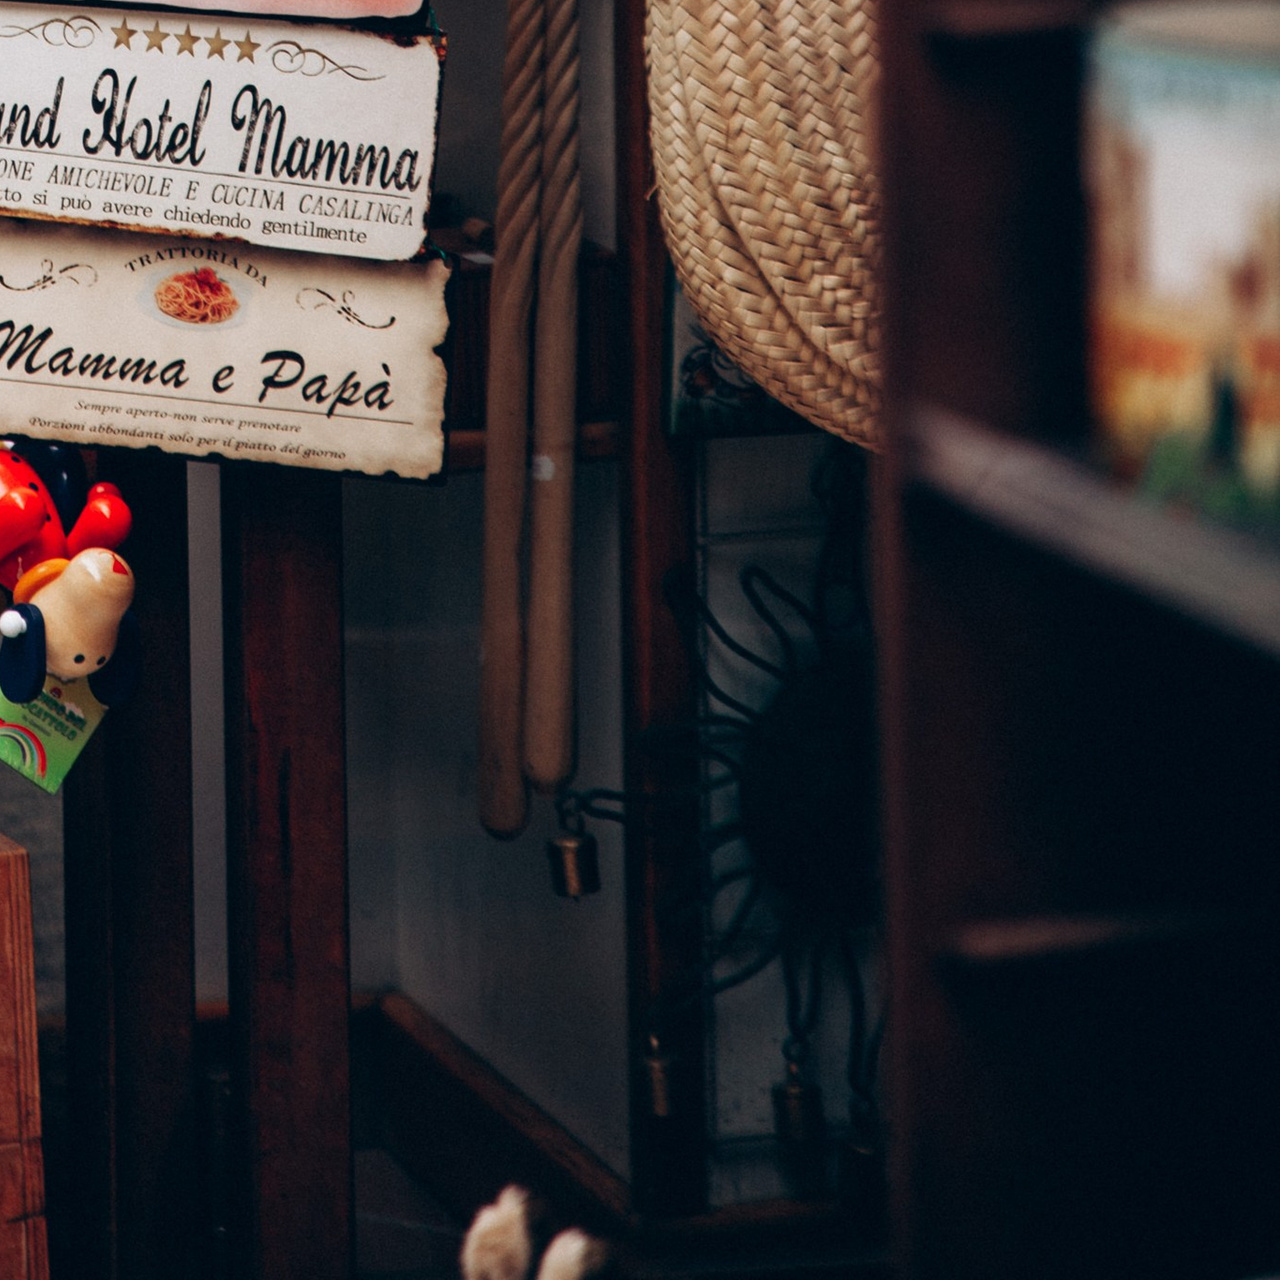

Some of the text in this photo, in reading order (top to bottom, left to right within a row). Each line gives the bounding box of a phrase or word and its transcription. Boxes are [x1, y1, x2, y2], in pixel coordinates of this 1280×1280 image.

[82, 67, 213, 168] Hotel
[230, 83, 422, 193] Mamma
[33, 189, 49, 206] si
[60, 193, 93, 212] può
[102, 201, 153, 218] avere
[163, 206, 252, 230] chiedendo
[261, 219, 368, 245] gentilmente
[46, 164, 172, 198] AMICHEVOLE
[185, 182, 199, 200] E
[210, 184, 286, 212] CUCINA
[298, 193, 414, 227] CASALINGA
[123, 245, 270, 289] TRATTORIA DA
[212, 364, 235, 394] e
[257, 349, 396, 418] Papà
[28, 416, 346, 460] Porzioni abbondanti solo per piatto del giorno
[74, 400, 302, 436] Sempre serve prenotare
